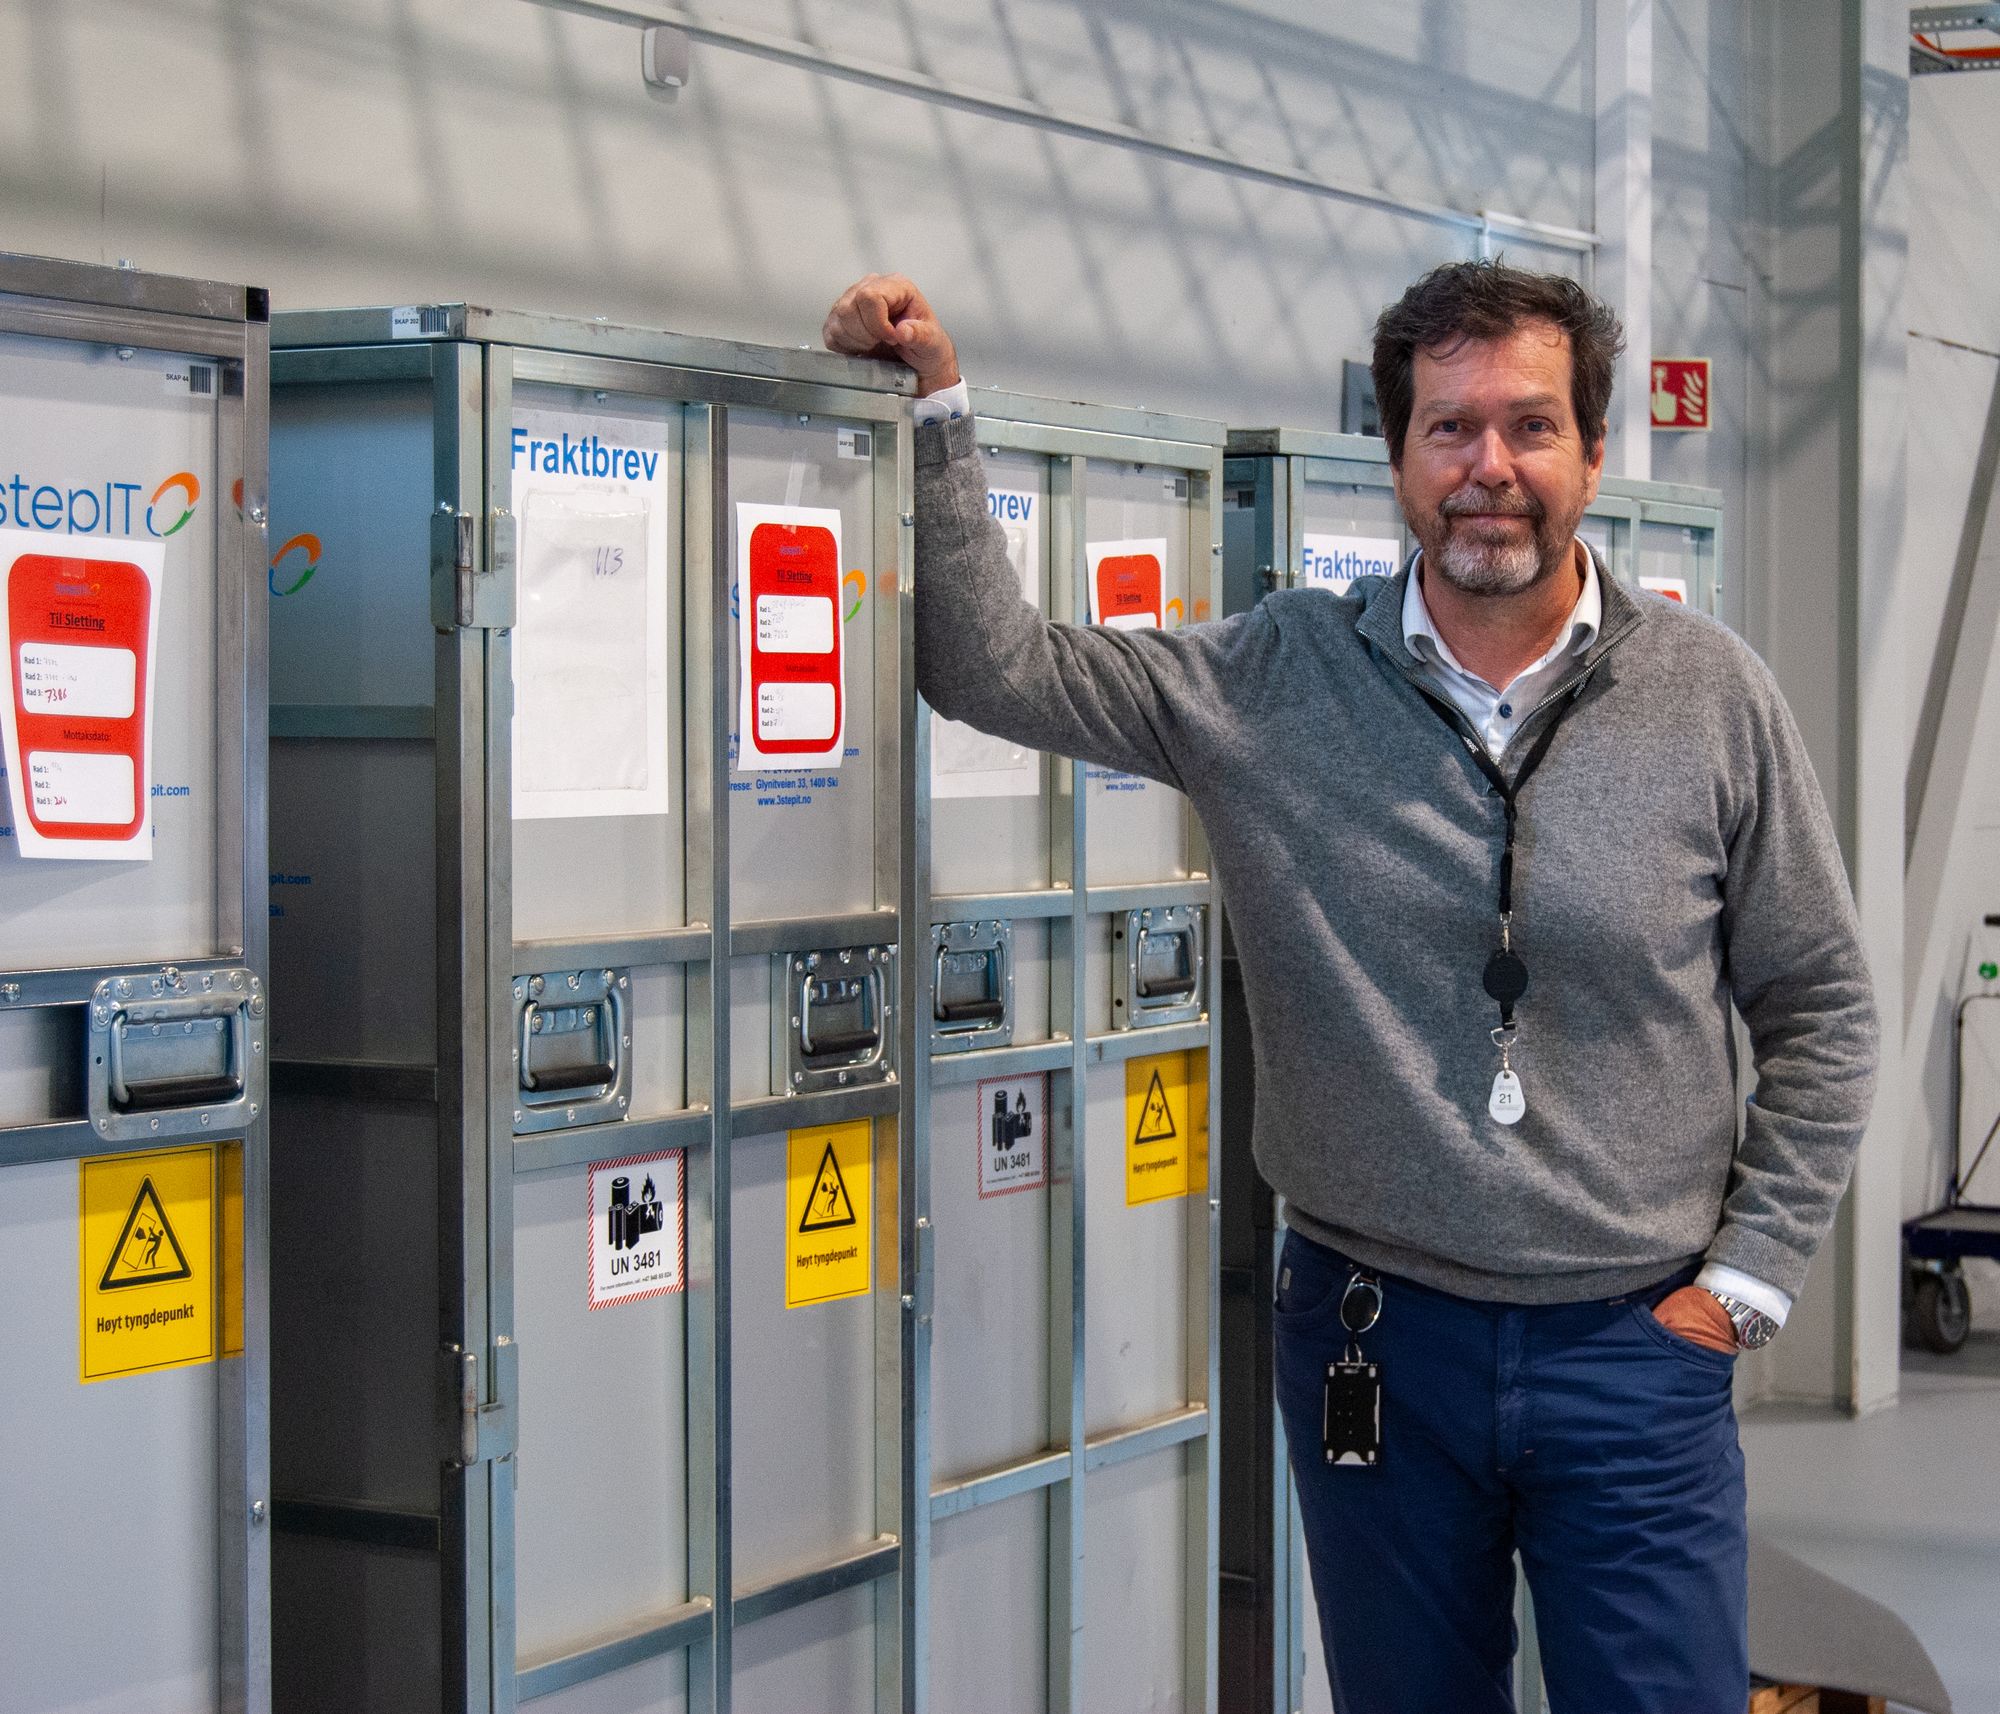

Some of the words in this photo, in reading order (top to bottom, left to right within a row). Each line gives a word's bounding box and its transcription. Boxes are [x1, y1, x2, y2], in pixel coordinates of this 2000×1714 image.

[166, 373, 181, 381] SKAP
[511, 427, 659, 481] Fraktbrev
[1302, 547, 1394, 580] Fraktbrev
[49, 611, 62, 628] Til
[65, 613, 105, 631] Sletting
[24, 656, 35, 665] Rad
[36, 657, 42, 666] 1:
[25, 672, 36, 681] Rad
[37, 673, 43, 682] 2:
[26, 688, 37, 697] Rad
[63, 729, 112, 742] Mottaksdato:
[33, 765, 43, 774] Rad
[35, 780, 45, 789] Rad
[756, 779, 796, 792] Glynitveien
[810, 776, 826, 788] 1400
[827, 776, 839, 788] Ski
[36, 797, 46, 805] Rad
[757, 794, 812, 806] www.3stepit.no
[1499, 1092, 1512, 1104] 21
[993, 1156, 1008, 1173] UN
[1010, 1152, 1031, 1170] 3481
[611, 1255, 630, 1276] UN
[633, 1249, 661, 1271] 3481
[797, 1254, 812, 1270] Høyt
[814, 1245, 858, 1267] tyngdepunkt
[97, 1317, 122, 1335] Høyt
[125, 1303, 195, 1332] tyngdepunkt
